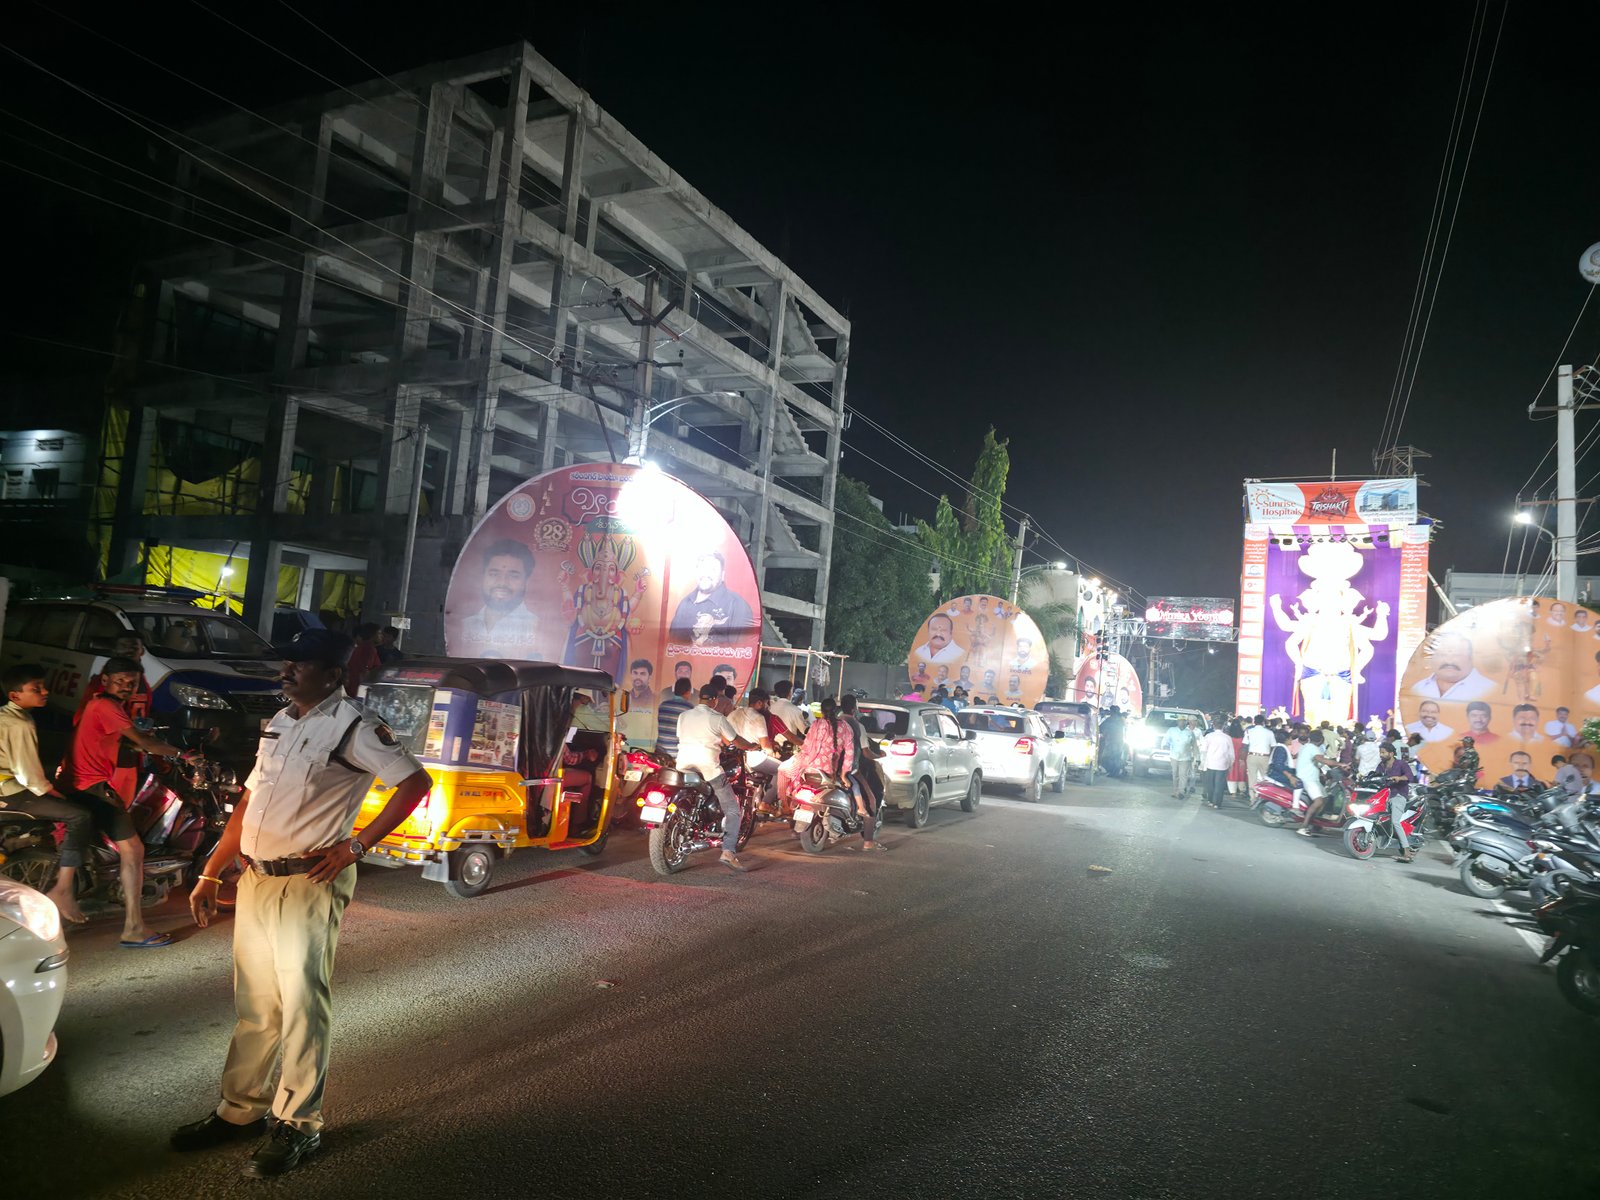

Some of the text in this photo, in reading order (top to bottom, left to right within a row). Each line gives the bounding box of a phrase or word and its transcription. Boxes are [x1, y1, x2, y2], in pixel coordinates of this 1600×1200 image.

[1262, 508, 1302, 516] Hospitals
[1310, 499, 1349, 514] TRISHAKTI
[543, 524, 563, 540] 28
[48, 668, 82, 698] ICE
